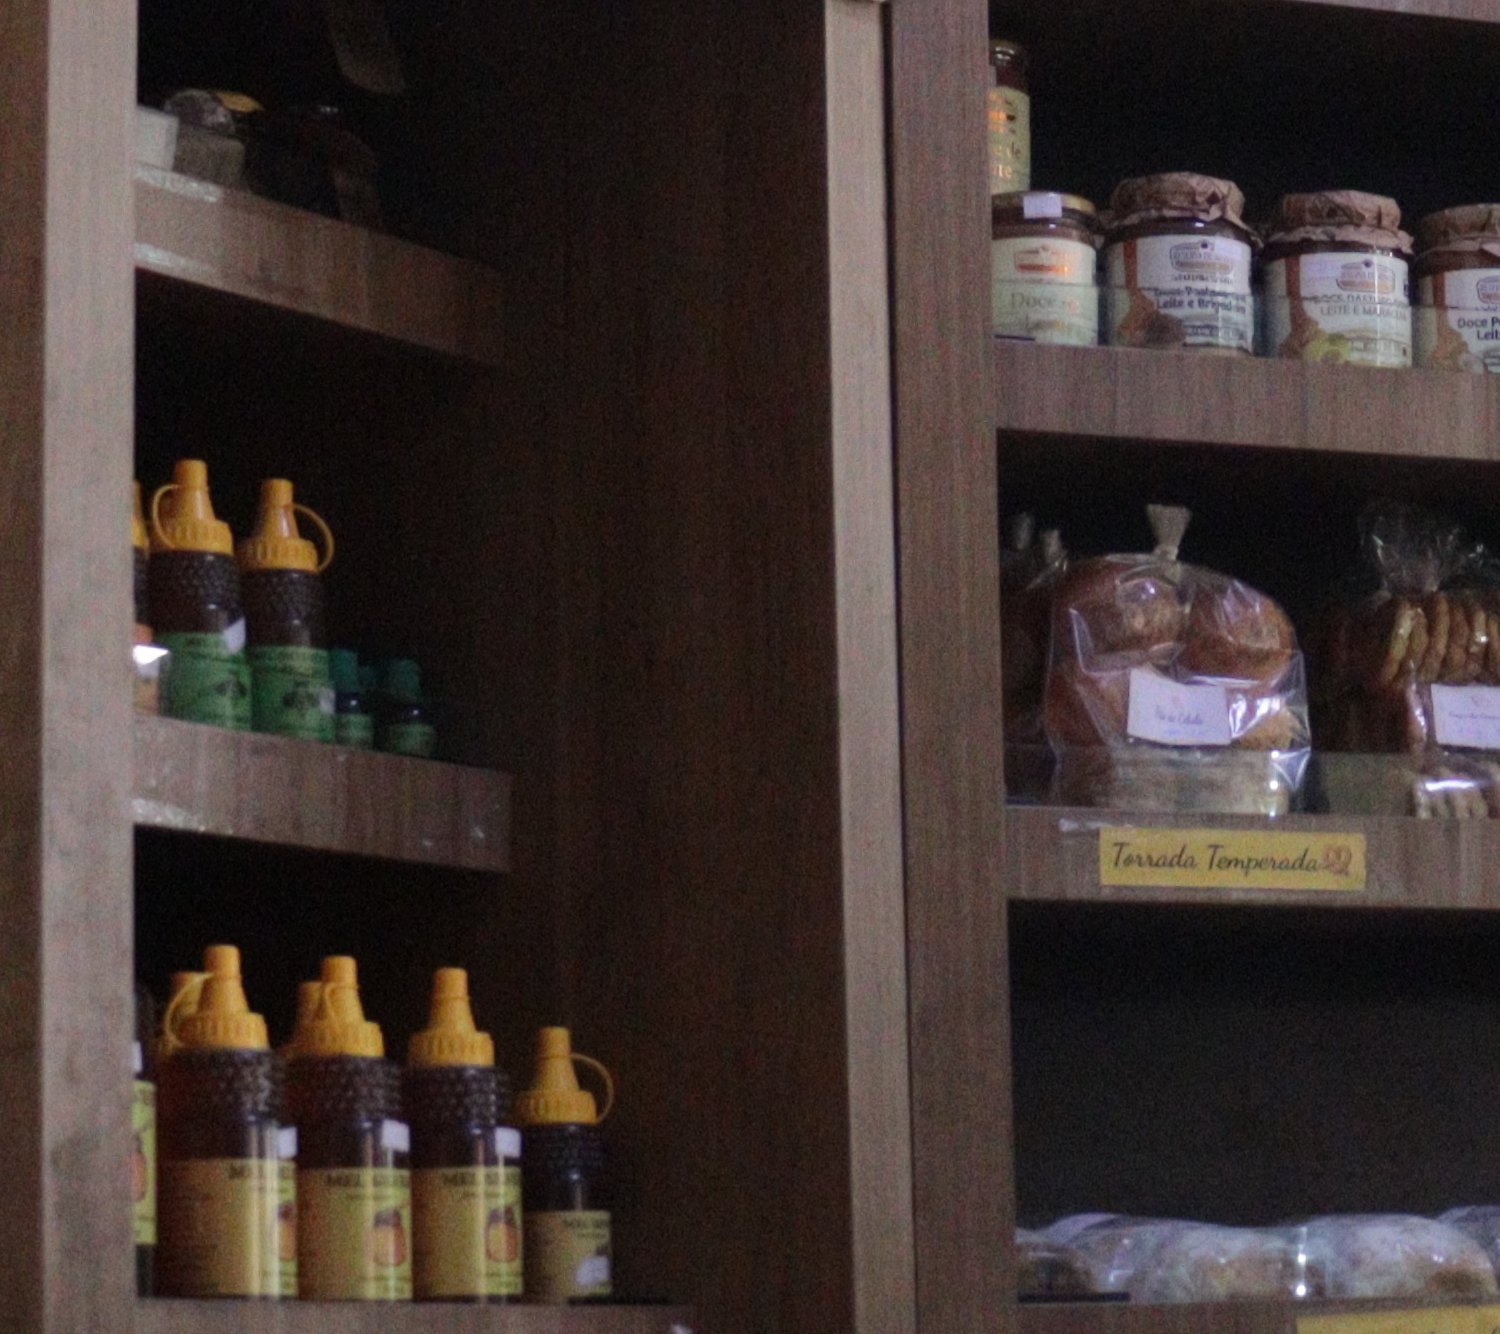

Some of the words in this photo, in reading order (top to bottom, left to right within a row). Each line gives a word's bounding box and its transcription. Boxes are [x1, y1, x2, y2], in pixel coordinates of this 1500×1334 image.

[1457, 317, 1489, 329] Doce
[1111, 841, 1198, 870] Torrada
[1207, 842, 1319, 876] Temperada
